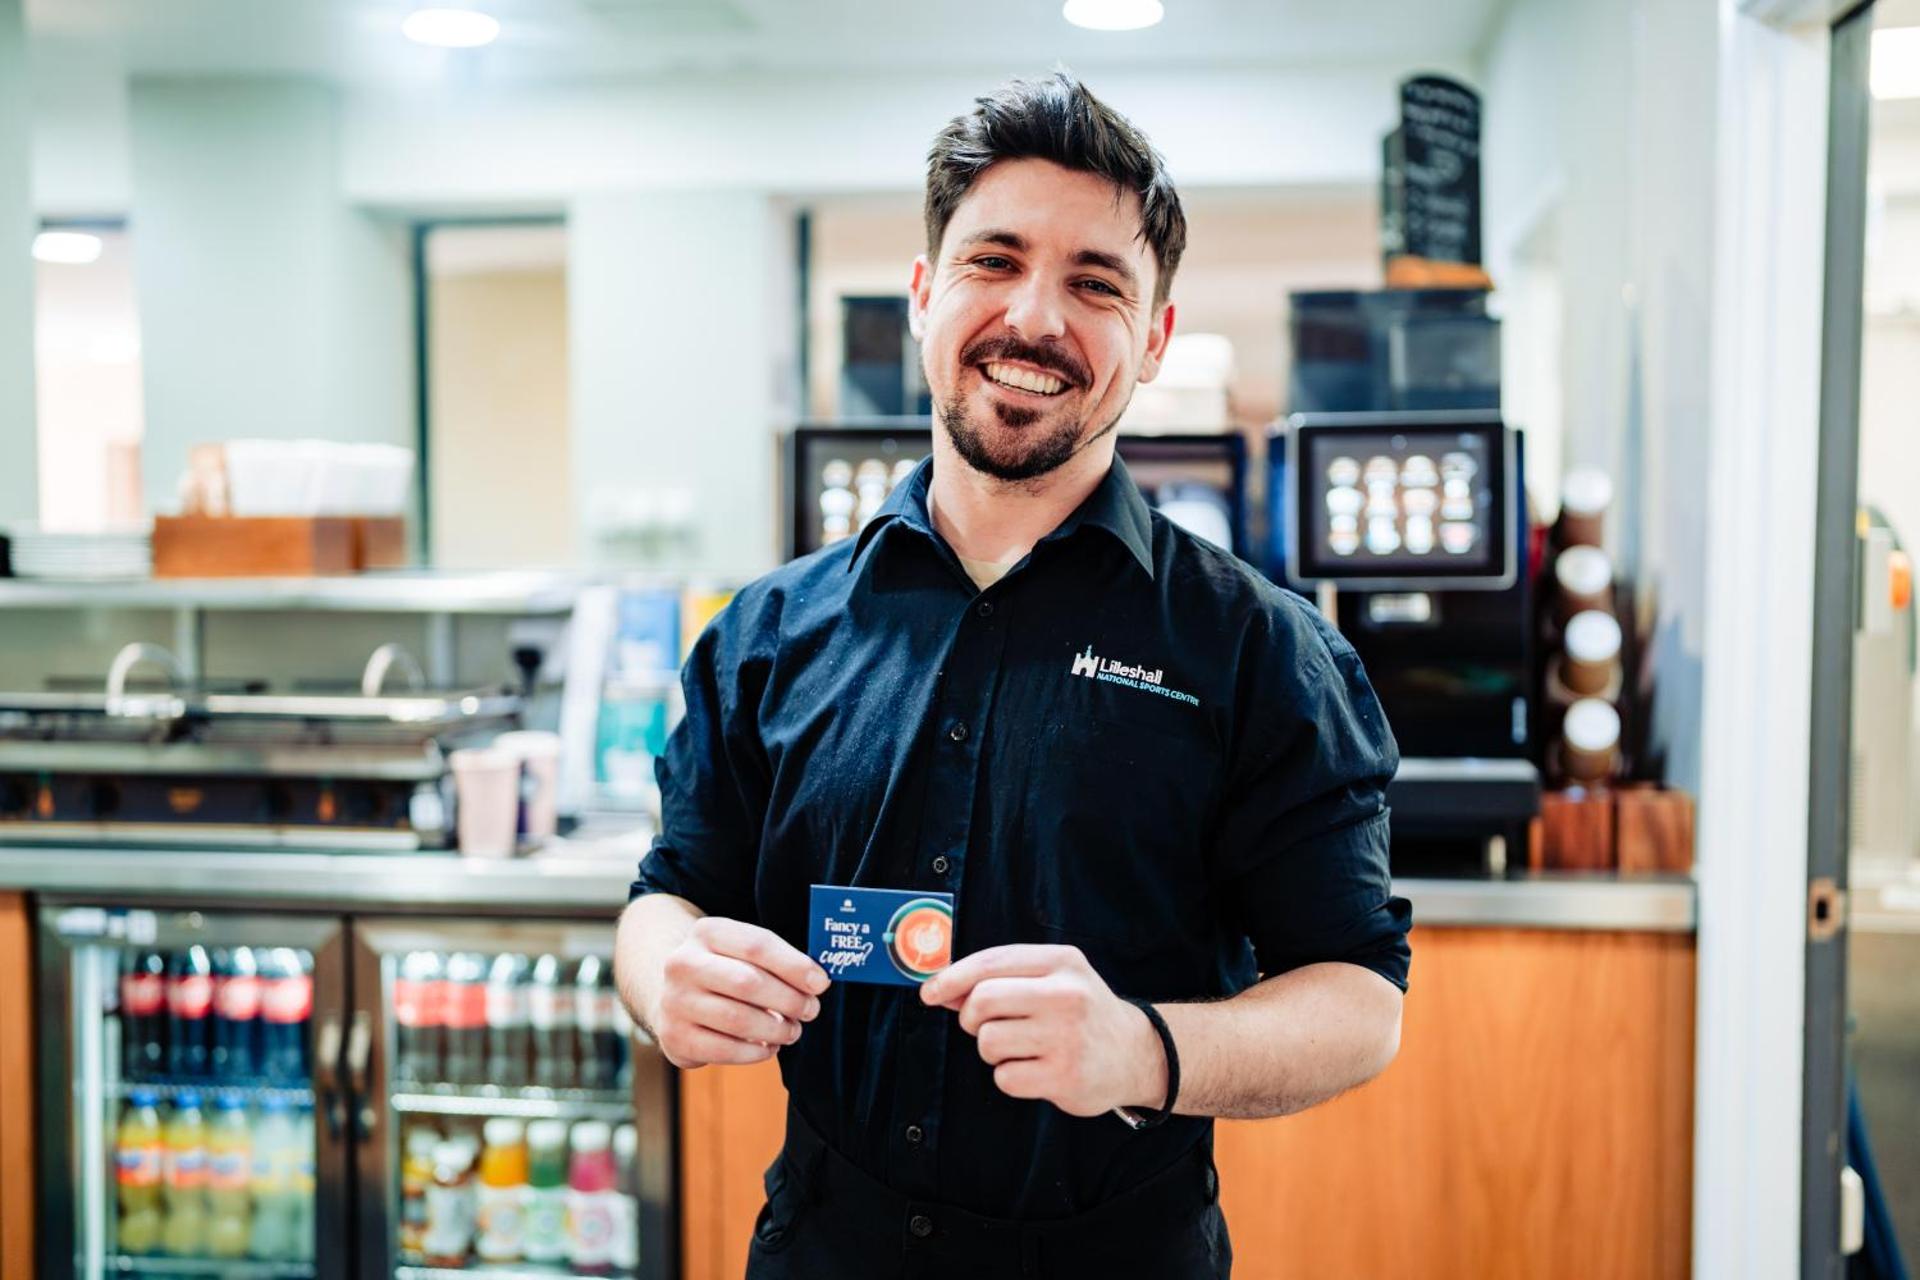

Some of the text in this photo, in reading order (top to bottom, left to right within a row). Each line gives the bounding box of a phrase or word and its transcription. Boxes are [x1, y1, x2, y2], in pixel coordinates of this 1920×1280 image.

[1100, 658, 1164, 685] Lilleshall
[1097, 673, 1139, 688] NATIONAL
[1139, 682, 1170, 697] SPORTS
[824, 918, 870, 935] Fancy a
[831, 936, 862, 949] FREE
